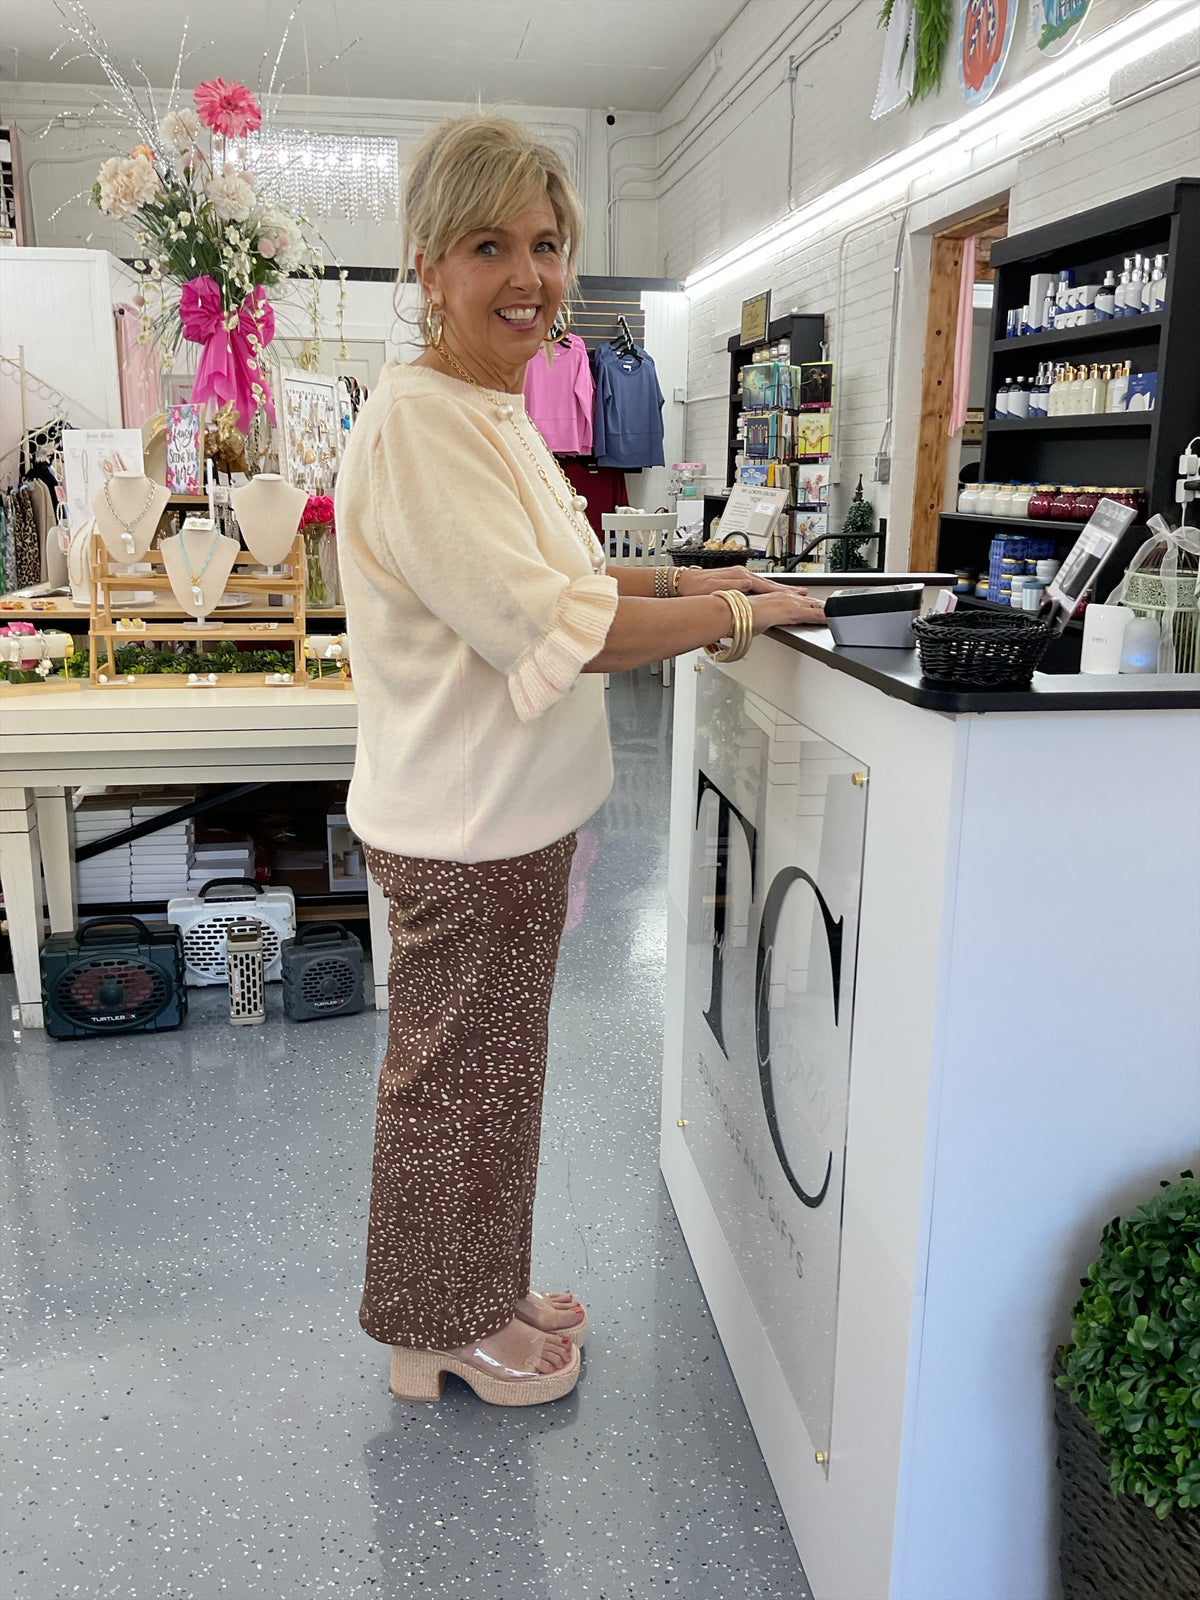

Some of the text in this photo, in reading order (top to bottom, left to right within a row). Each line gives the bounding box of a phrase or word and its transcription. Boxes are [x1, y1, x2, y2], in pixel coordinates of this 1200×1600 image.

[91, 1013, 136, 1022] TURTLEBOX
[698, 1052, 804, 1278] BOUTIQUE AND GIFTS
